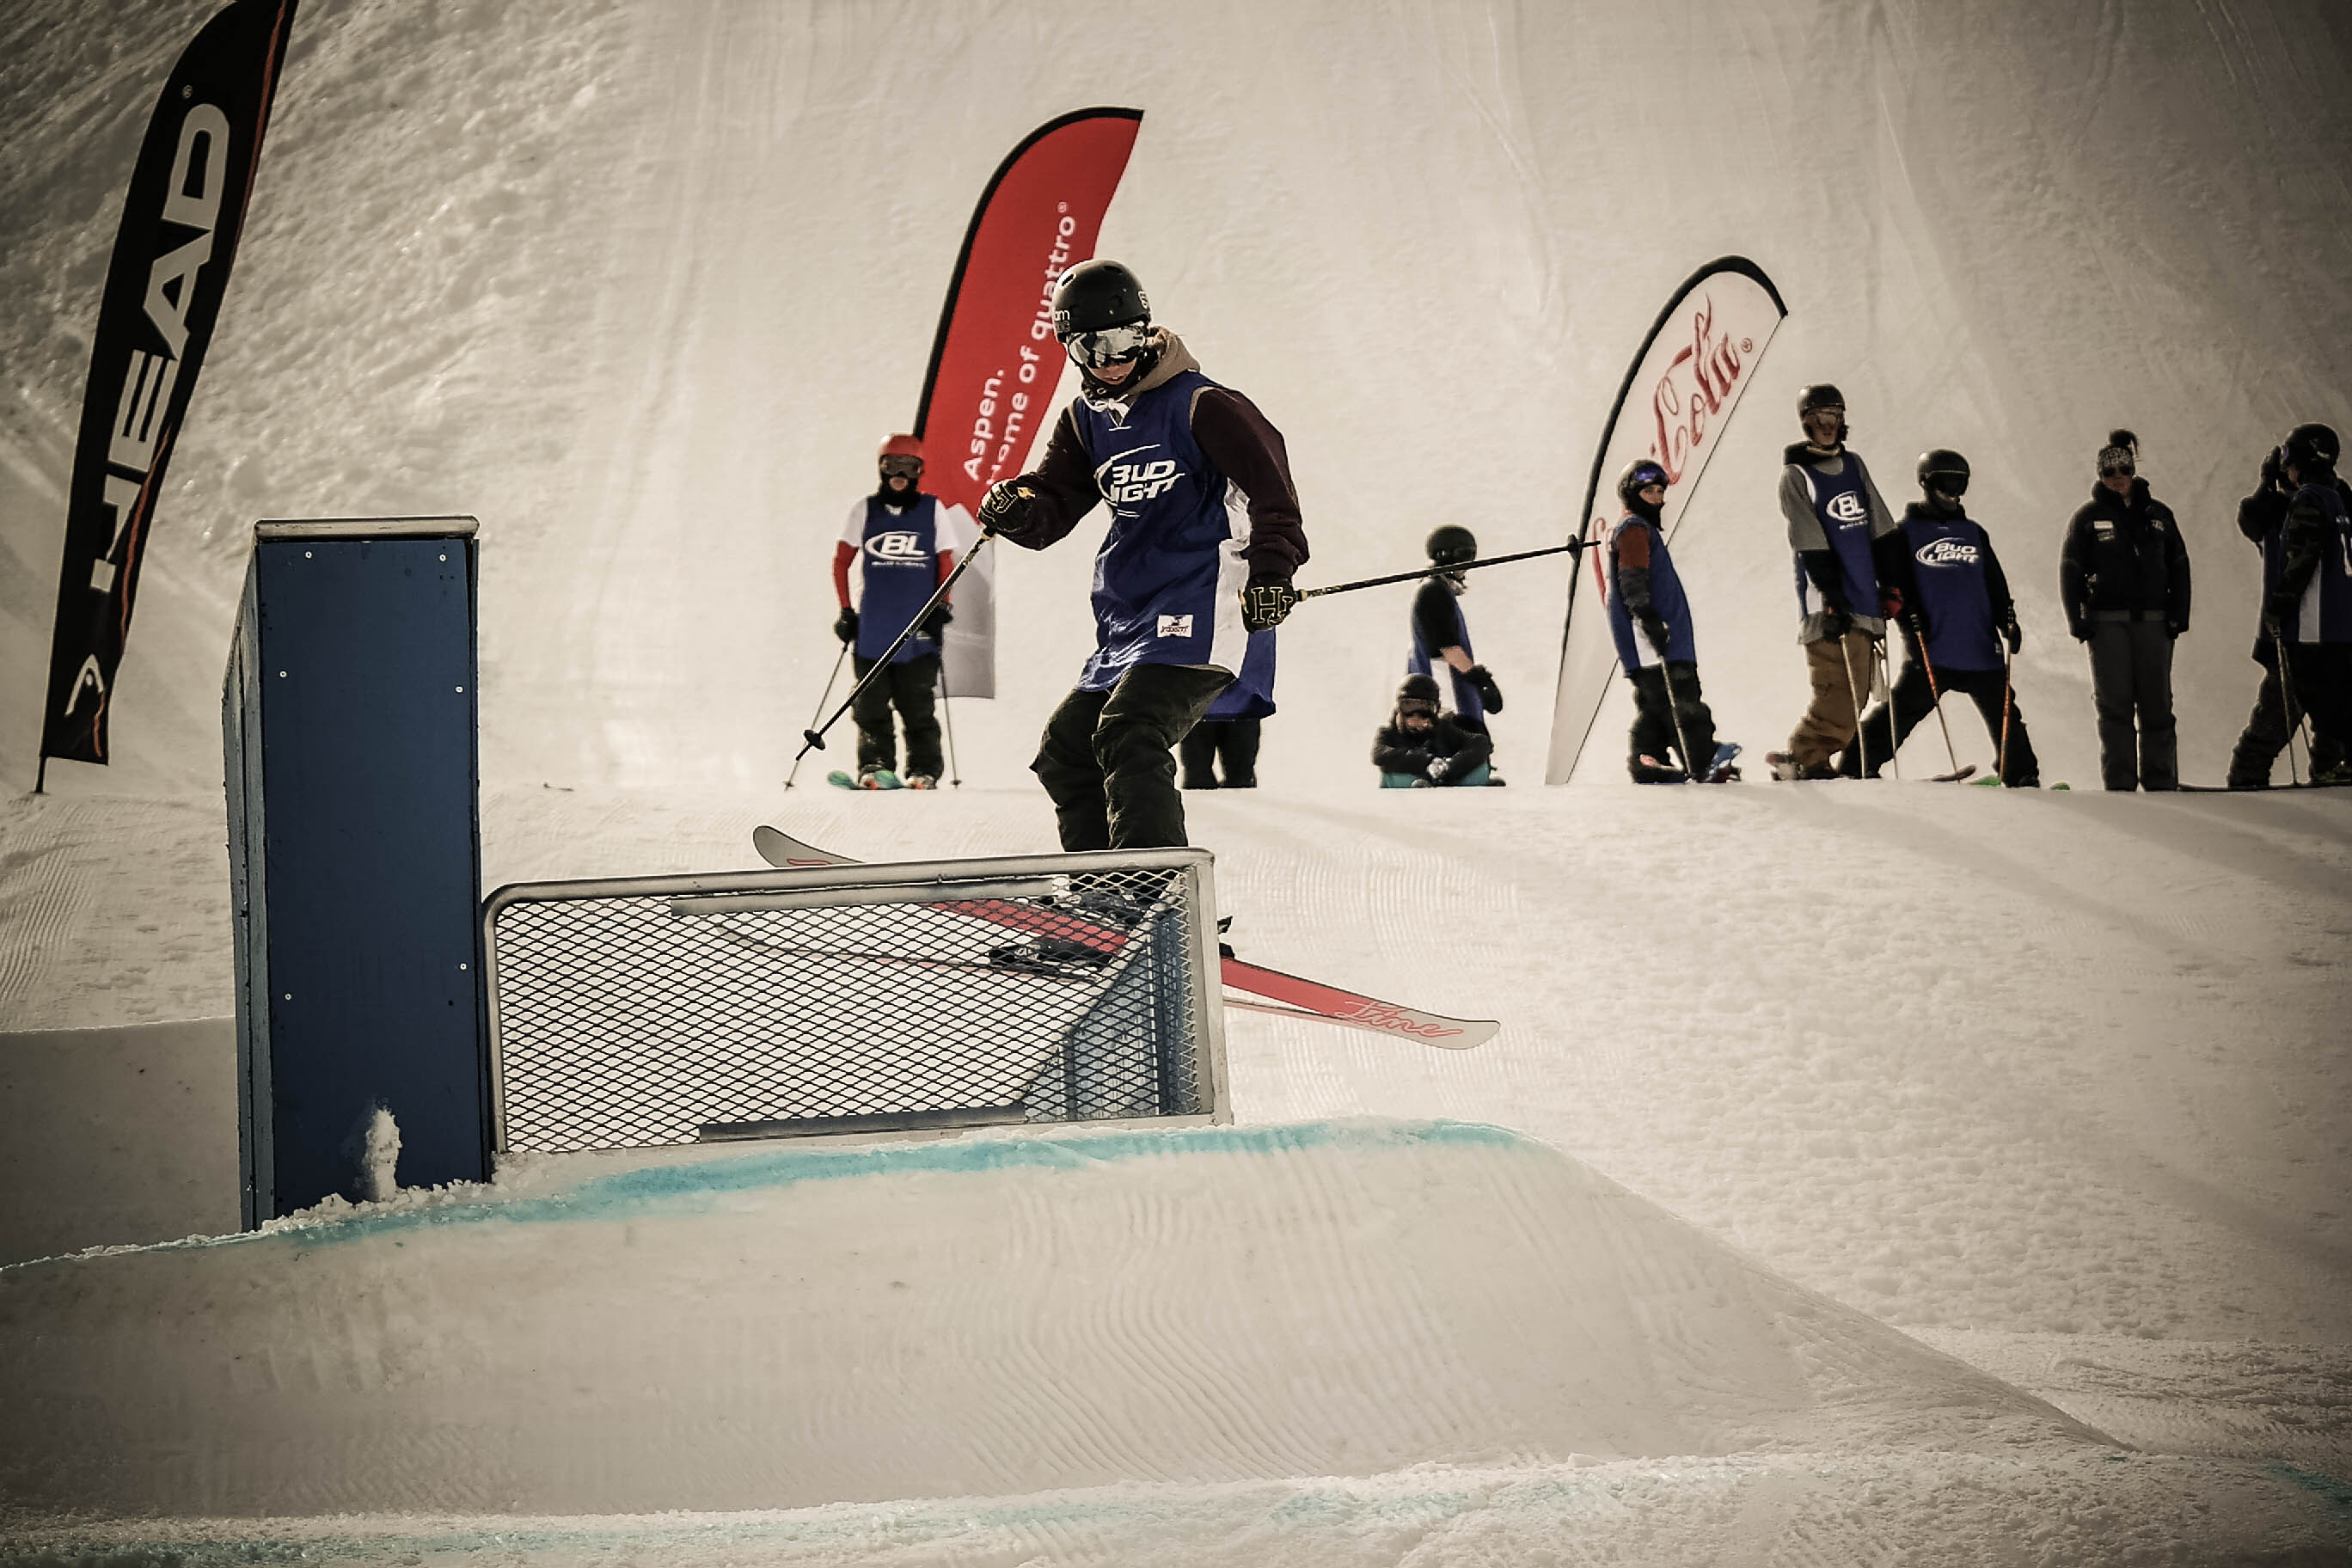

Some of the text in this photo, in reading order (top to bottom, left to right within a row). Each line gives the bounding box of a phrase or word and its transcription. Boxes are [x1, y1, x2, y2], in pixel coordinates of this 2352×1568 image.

[90, 102, 230, 593] HEAD
[1019, 345, 1040, 383] of
[1653, 292, 1741, 486] Cola
[963, 369, 1005, 481] Aspen.
[1837, 494, 1865, 517] BL
[880, 535, 926, 556] BL
[1926, 550, 1980, 564] LIGHT
[1933, 542, 1976, 554] BUD
